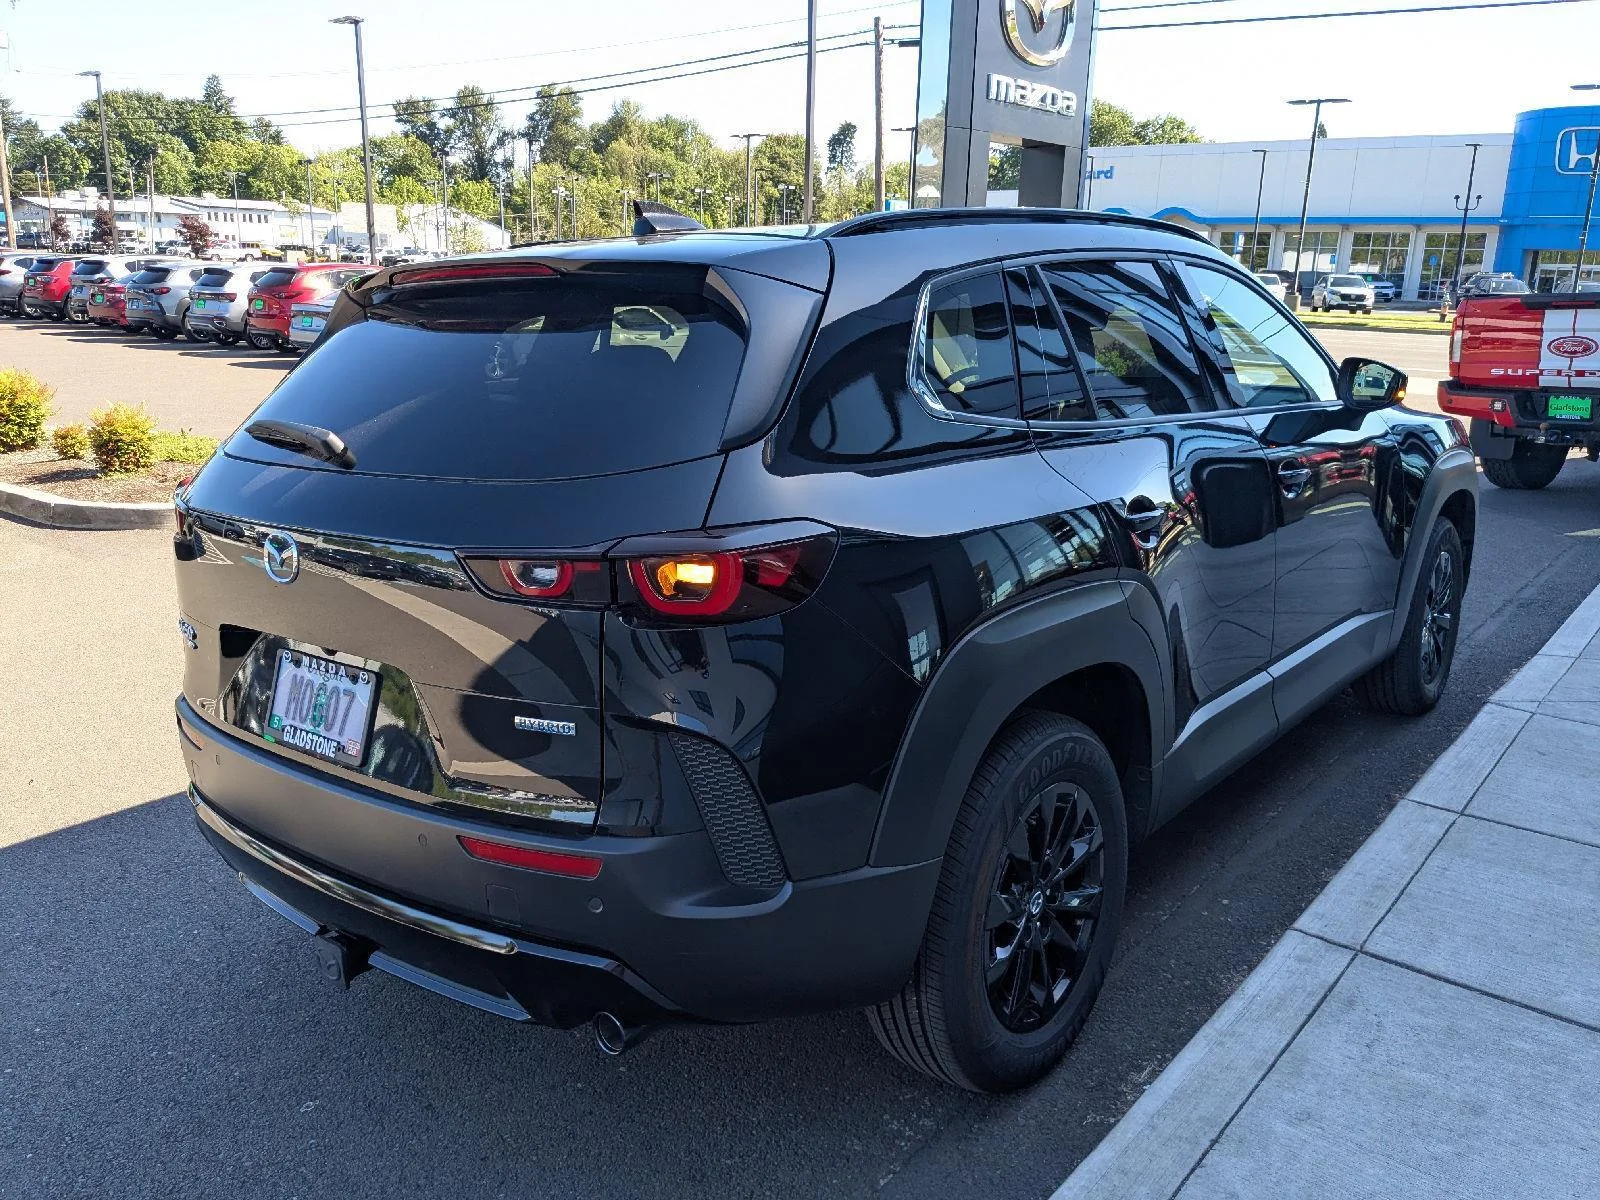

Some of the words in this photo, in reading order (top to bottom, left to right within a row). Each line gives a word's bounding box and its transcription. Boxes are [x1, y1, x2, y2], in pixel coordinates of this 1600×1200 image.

[985, 73, 1077, 117] mazda
[1558, 341, 1585, 352] Ford
[1490, 368, 1576, 377] SUPER
[1550, 403, 1590, 412] Gladstone
[302, 655, 346, 677] MAZDA
[273, 716, 280, 728] 5
[283, 726, 338, 758] GLADSTONE
